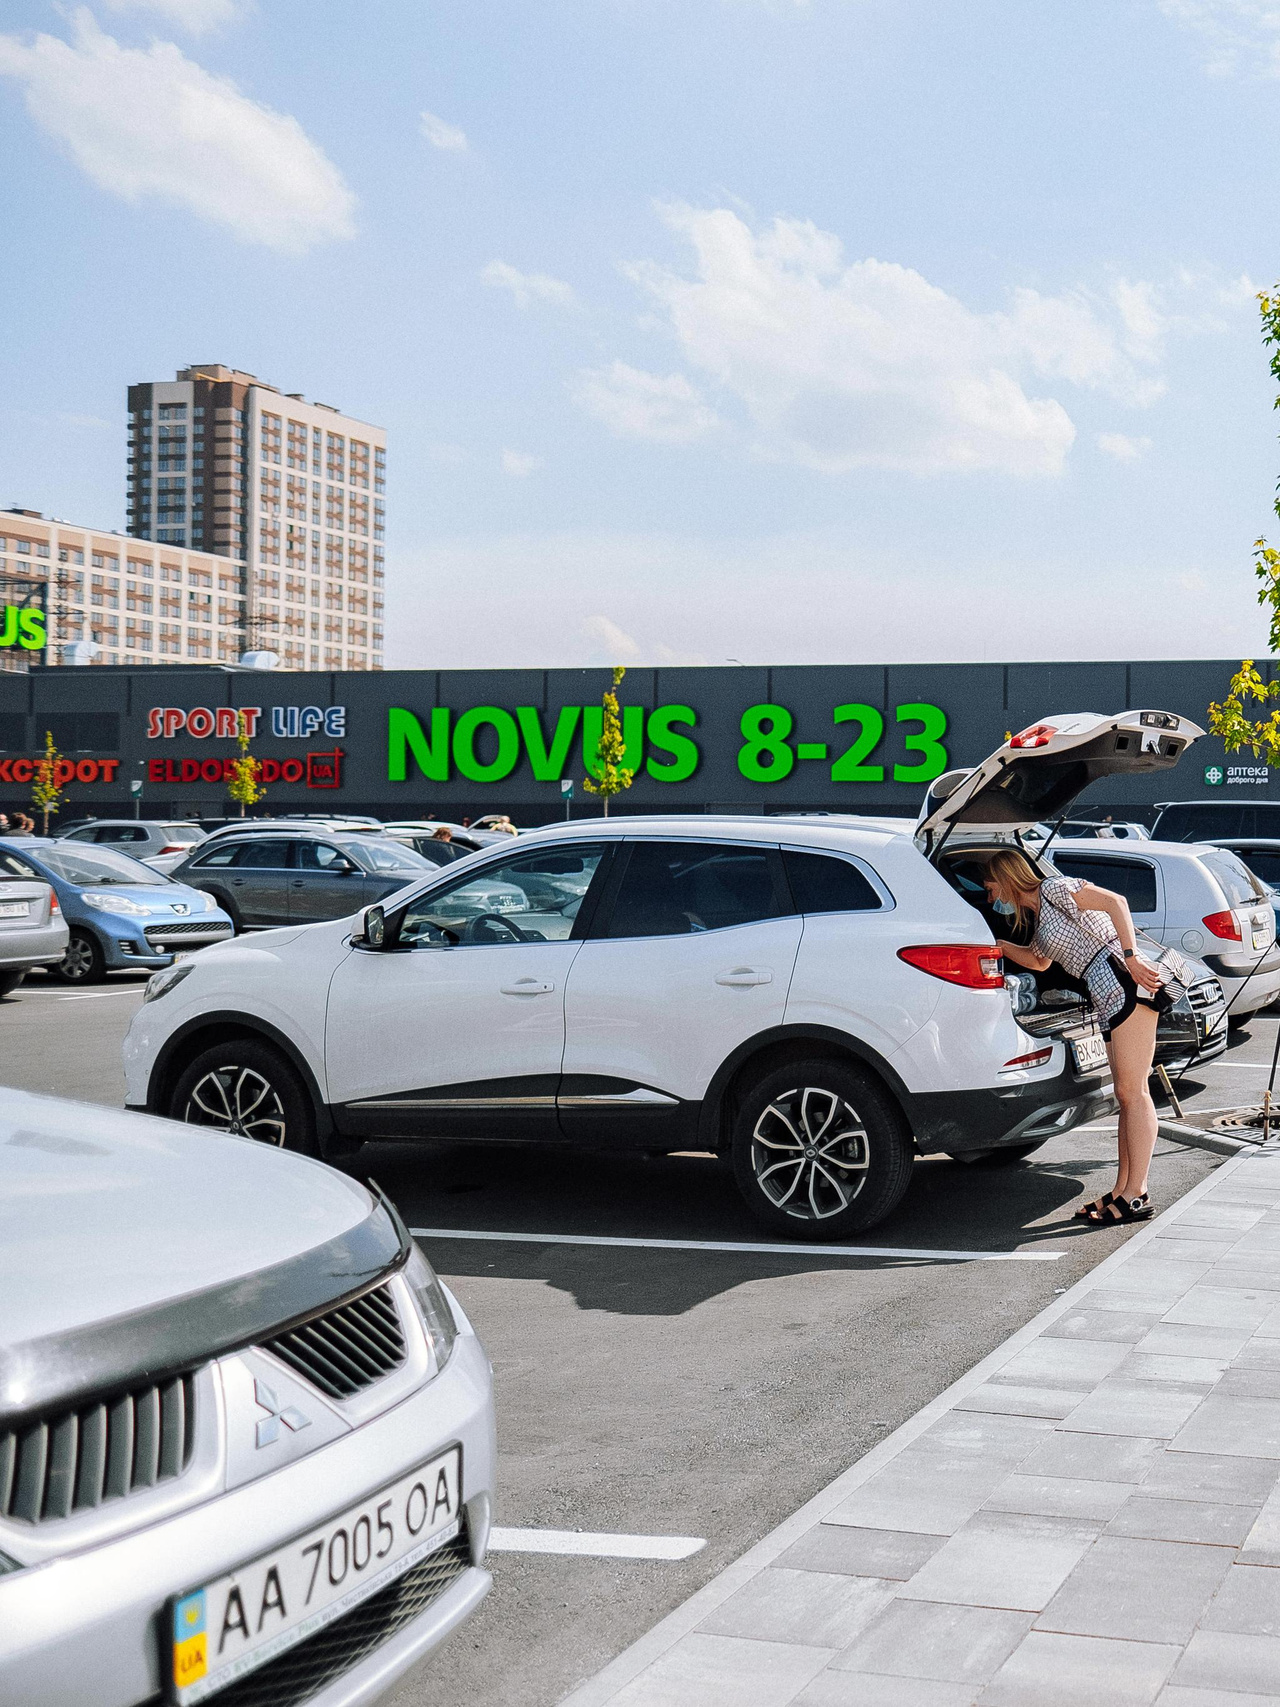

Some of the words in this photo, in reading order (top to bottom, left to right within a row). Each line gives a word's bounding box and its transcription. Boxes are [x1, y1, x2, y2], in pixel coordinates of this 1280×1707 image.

[147, 707, 262, 738] SPORT
[272, 706, 346, 738] LIFE
[388, 704, 700, 782] NOVUS
[737, 703, 948, 783] 8-23
[148, 759, 303, 782] ELDORDO
[313, 765, 333, 778] UA
[1227, 767, 1269, 776] аптека
[1227, 776, 1255, 784] доброго
[1091, 1039, 1105, 1057] 400
[217, 1564, 287, 1655] AA
[302, 1498, 394, 1606] 7005
[406, 1466, 451, 1536] OA
